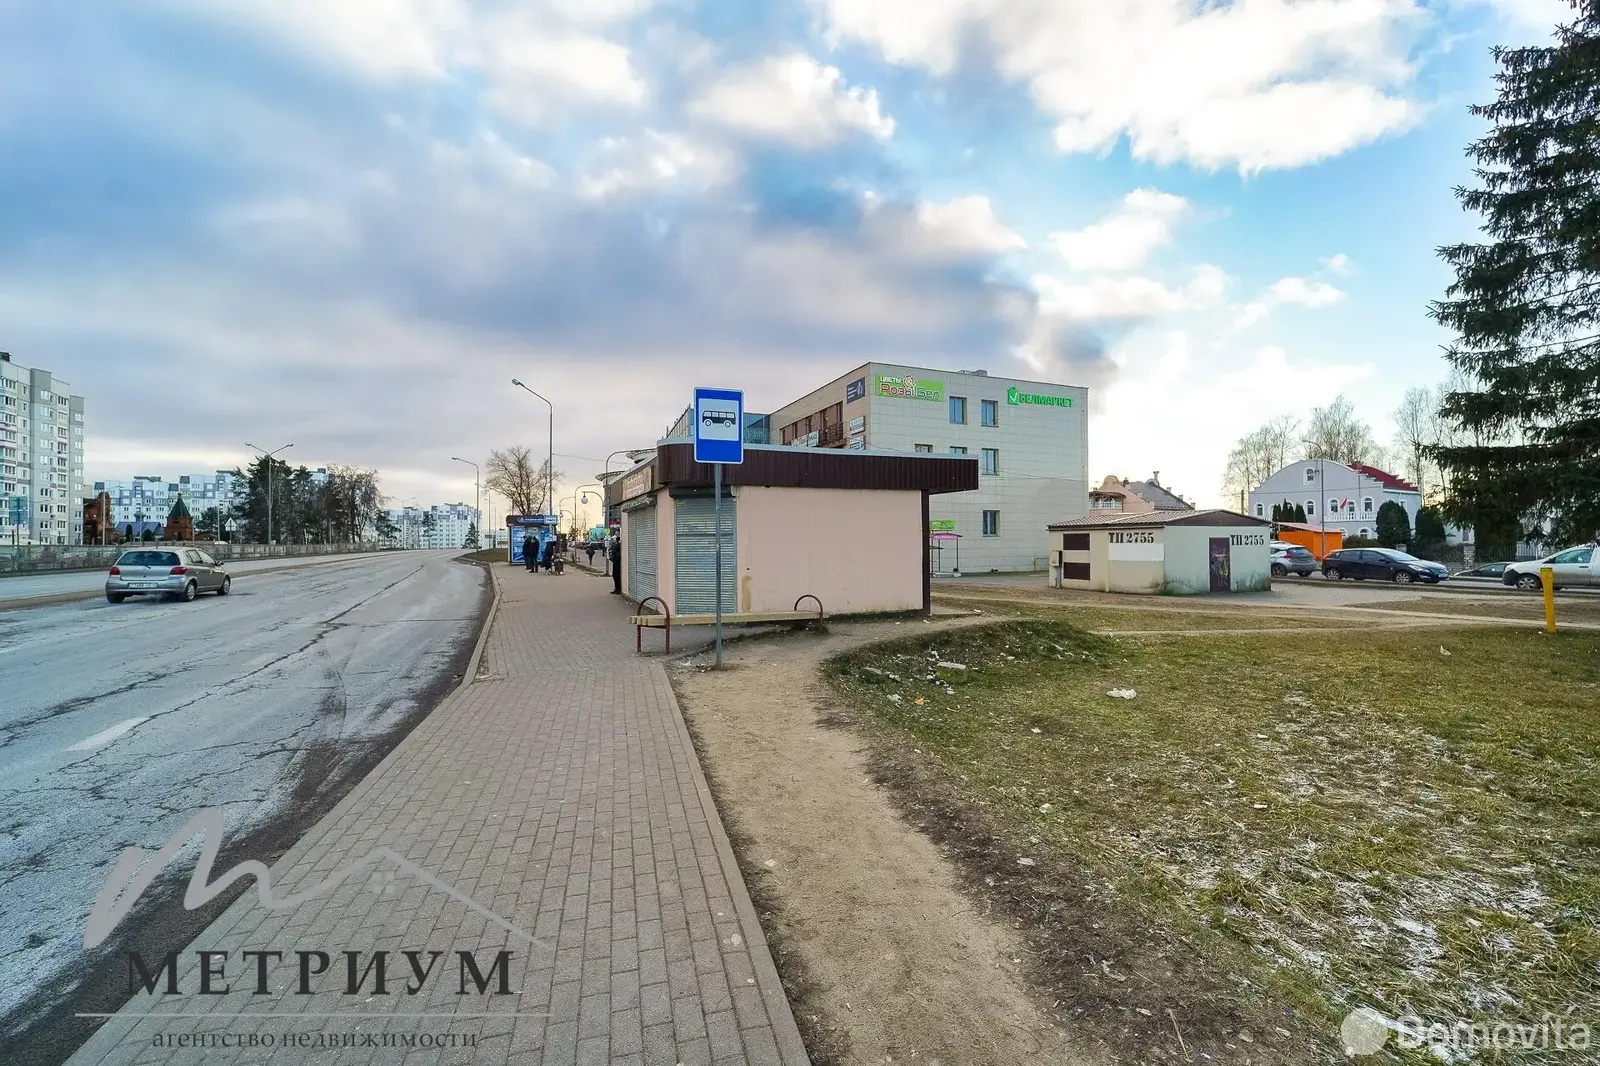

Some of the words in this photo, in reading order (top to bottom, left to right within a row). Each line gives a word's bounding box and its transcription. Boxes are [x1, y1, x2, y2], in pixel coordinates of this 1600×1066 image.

[1019, 392, 1074, 407] БЕЛМАРКЕТ
[1126, 532, 1155, 543] 2755
[1244, 535, 1264, 545] 2755
